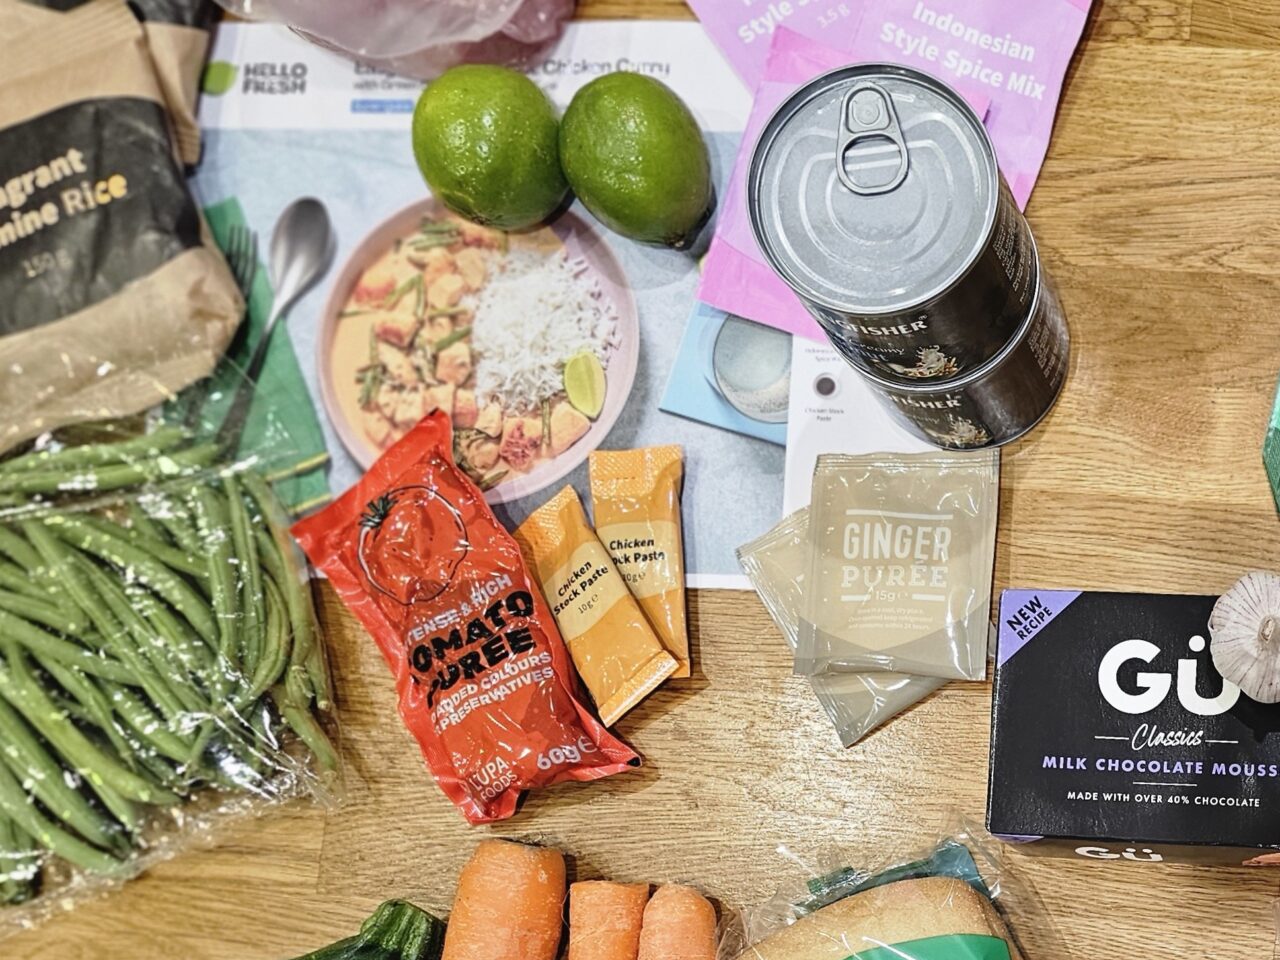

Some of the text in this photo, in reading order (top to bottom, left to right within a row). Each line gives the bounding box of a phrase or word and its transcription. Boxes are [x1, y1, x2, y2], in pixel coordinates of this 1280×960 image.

[738, 1, 794, 43] Style
[912, 1, 1036, 63] Indonesian
[245, 62, 307, 78] HELLO
[879, 22, 1047, 101] Style Spice Mix
[242, 80, 305, 95] FRESH
[61, 173, 127, 217] Rice
[609, 539, 655, 551] Chicken
[843, 522, 952, 561] GINGER
[634, 551, 665, 563] Paste
[558, 561, 592, 597] Chicken
[841, 560, 948, 588] PURÉE
[554, 566, 609, 616] Stock Paste
[1006, 596, 1042, 632] NEW
[1016, 606, 1053, 641] RECIPE
[1132, 723, 1204, 750] Classics
[537, 744, 581, 770] 60g
[1042, 756, 1088, 770] MILK
[1096, 758, 1203, 775] CHOCOLATE
[1067, 791, 1260, 808] MADE WITH OVER CHOCOLATE
[1075, 846, 1163, 862] Gü
